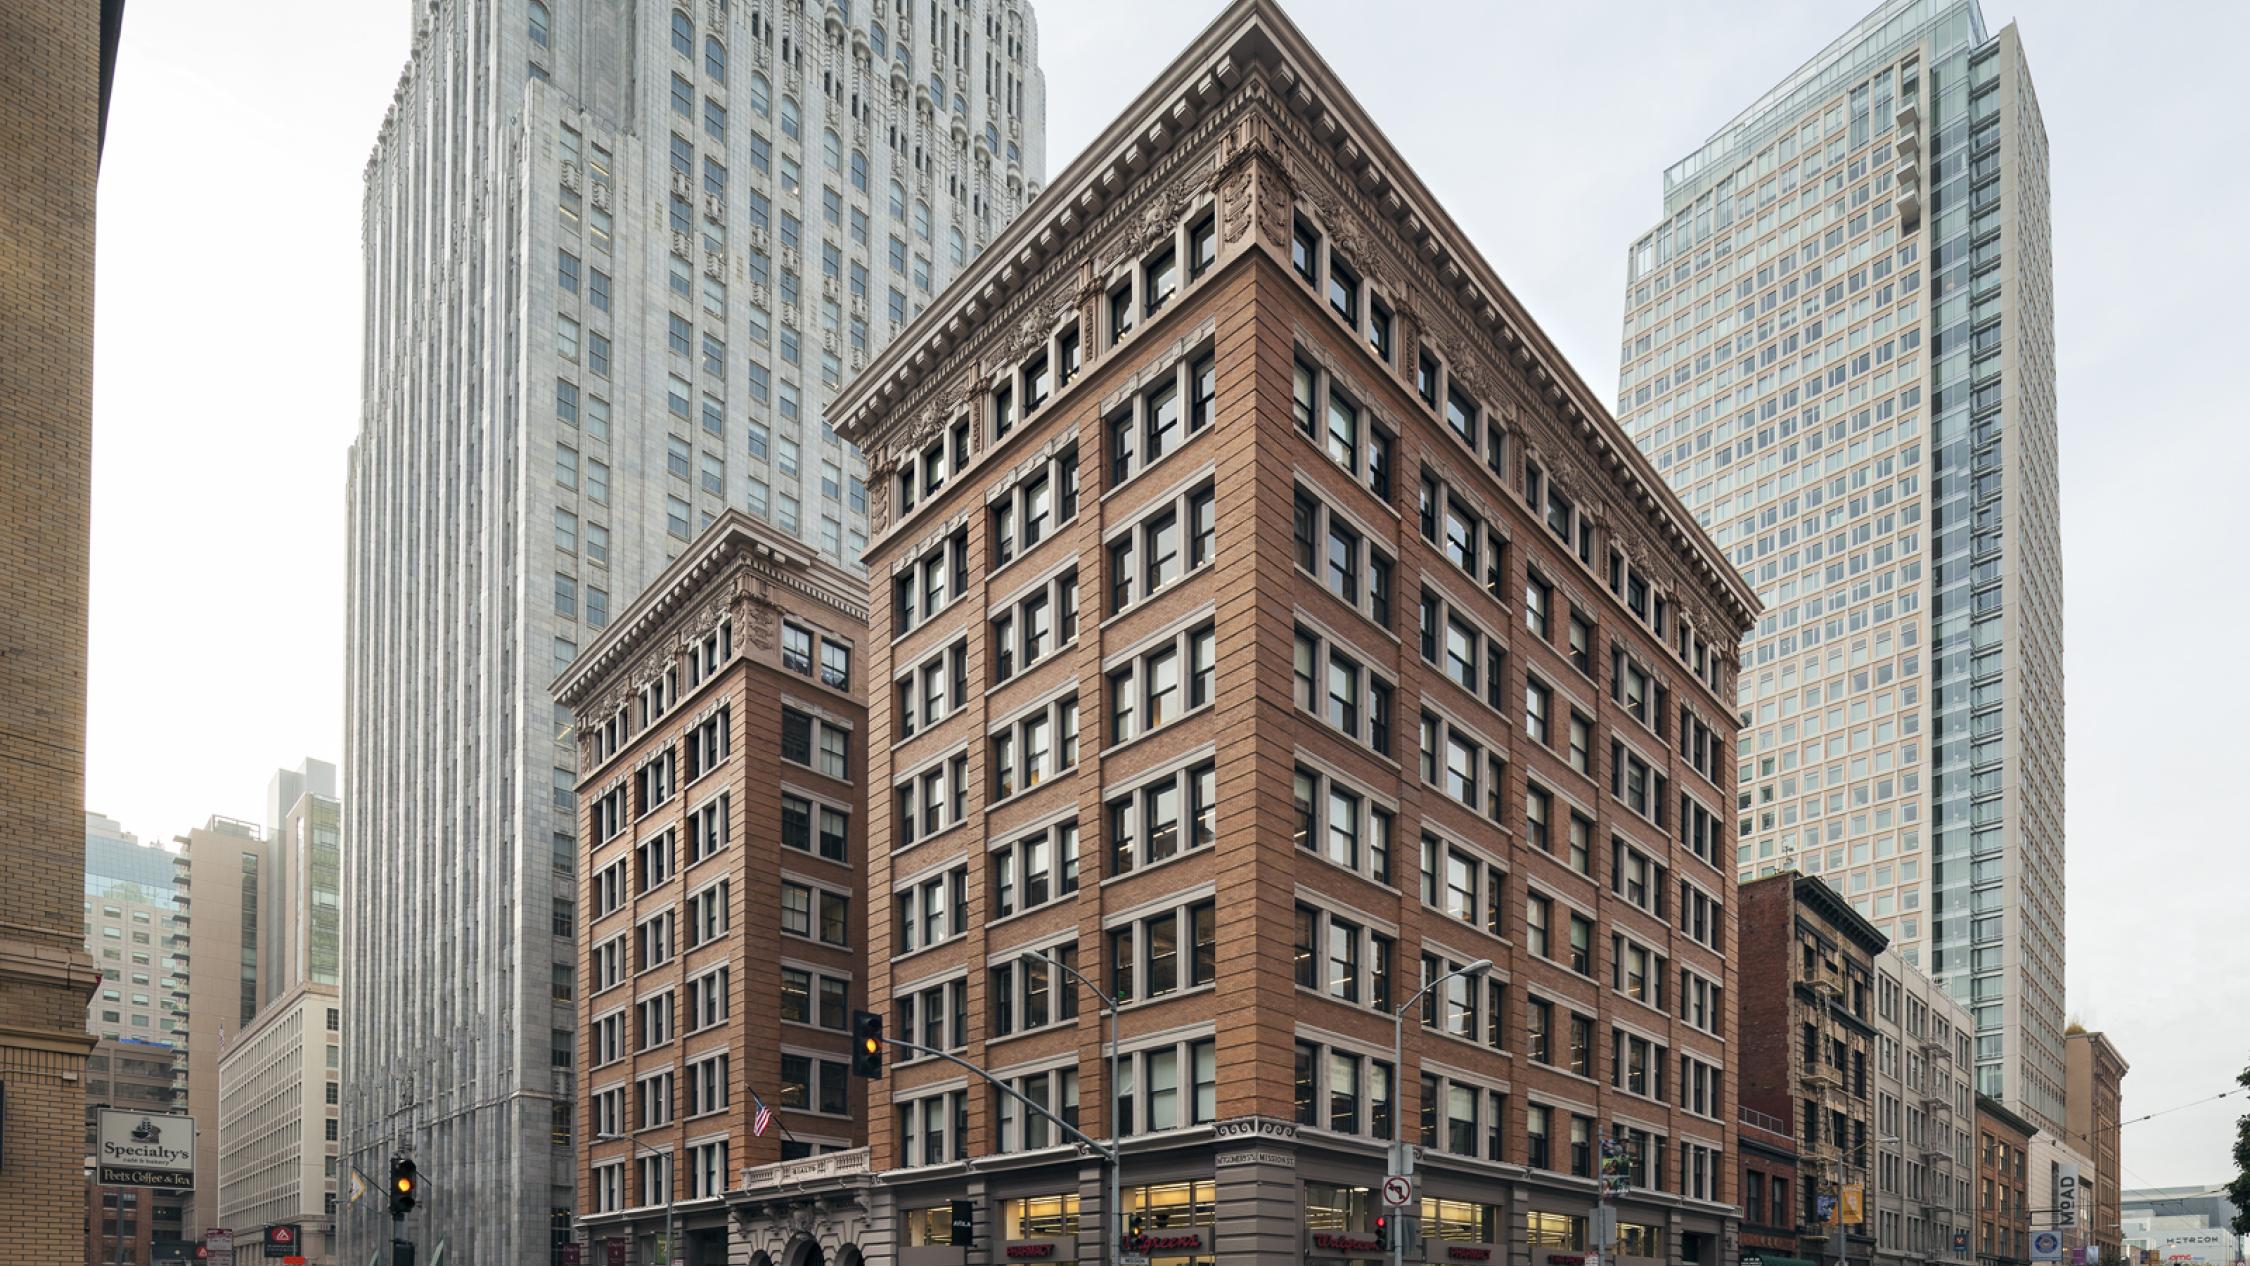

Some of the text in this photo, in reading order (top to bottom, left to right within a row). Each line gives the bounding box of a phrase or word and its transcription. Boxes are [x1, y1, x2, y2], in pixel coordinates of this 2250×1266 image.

[104, 1141, 190, 1162] Specialty's
[132, 1171, 162, 1184] Coffee
[175, 1173, 191, 1185] Tea
